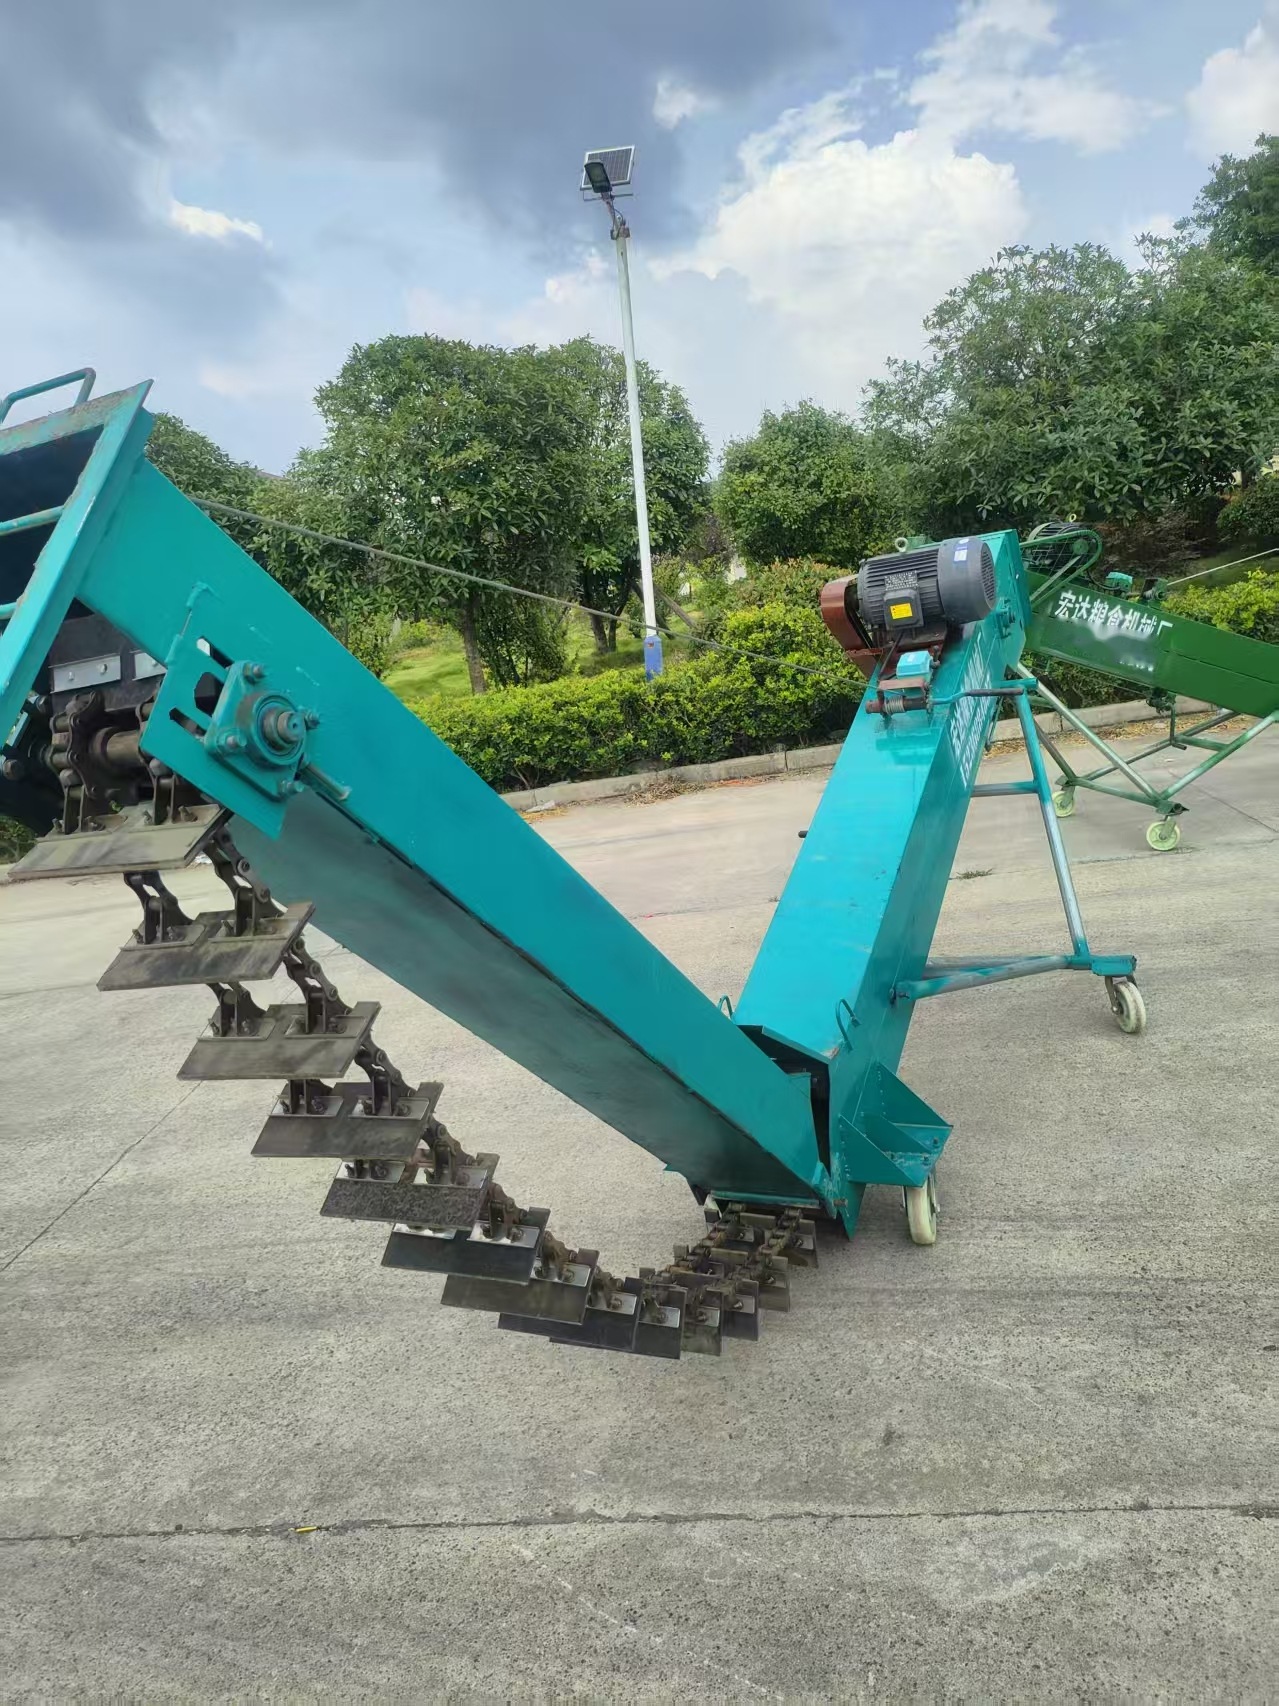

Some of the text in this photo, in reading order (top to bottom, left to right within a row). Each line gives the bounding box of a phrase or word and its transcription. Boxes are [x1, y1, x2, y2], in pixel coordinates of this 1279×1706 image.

[1055, 590, 1173, 635] 宏达粮食机械厂
